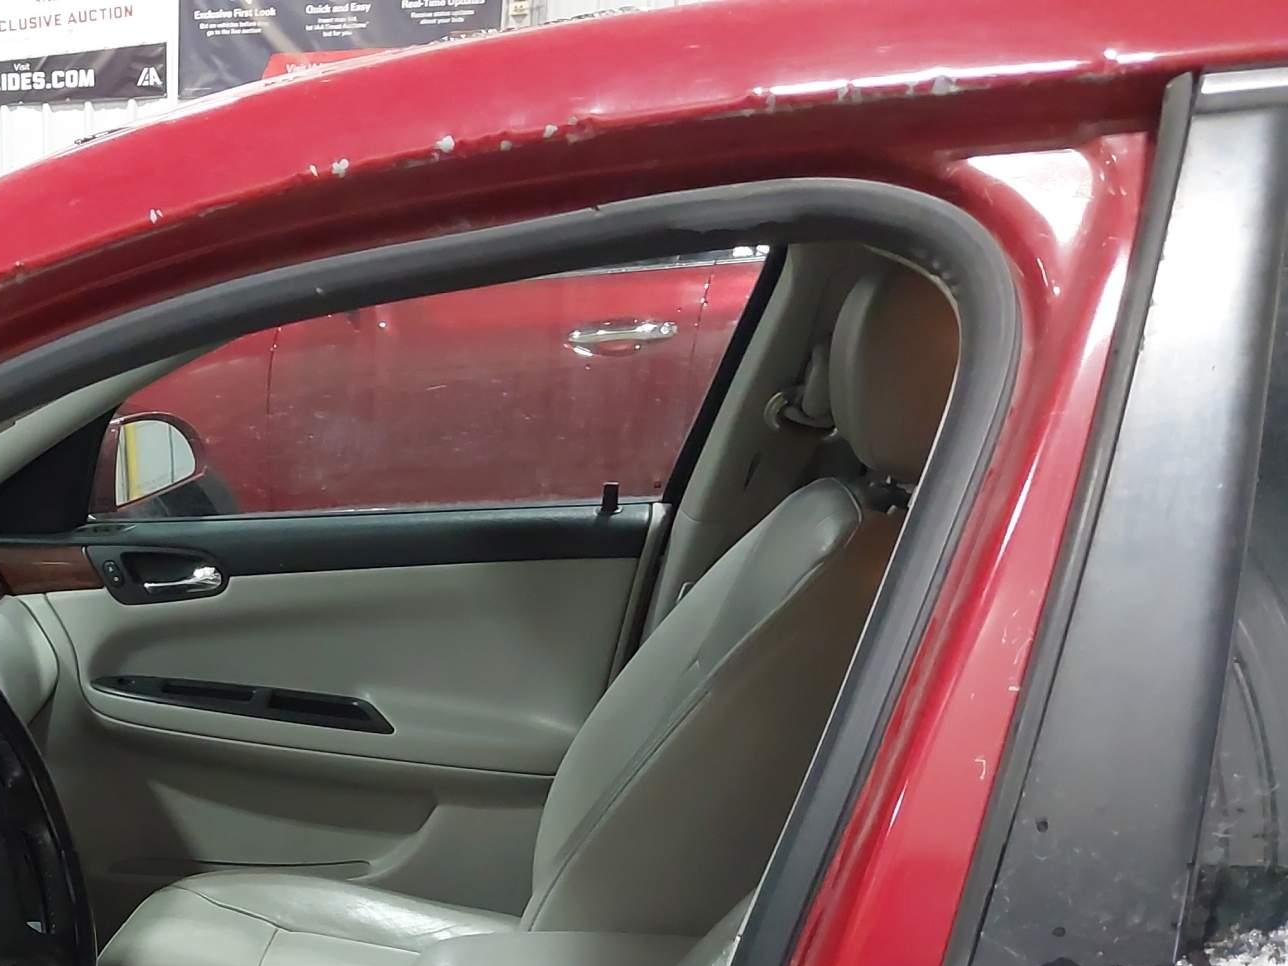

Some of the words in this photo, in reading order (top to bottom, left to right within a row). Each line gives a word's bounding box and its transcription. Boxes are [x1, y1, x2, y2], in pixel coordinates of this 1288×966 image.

[233, 8, 253, 18] First
[254, 7, 276, 17] Look
[306, 4, 331, 14] Quick
[332, 3, 349, 12] and
[350, 2, 371, 13] Easy
[68, 5, 134, 24] AUCTION
[13, 63, 30, 71] Visit
